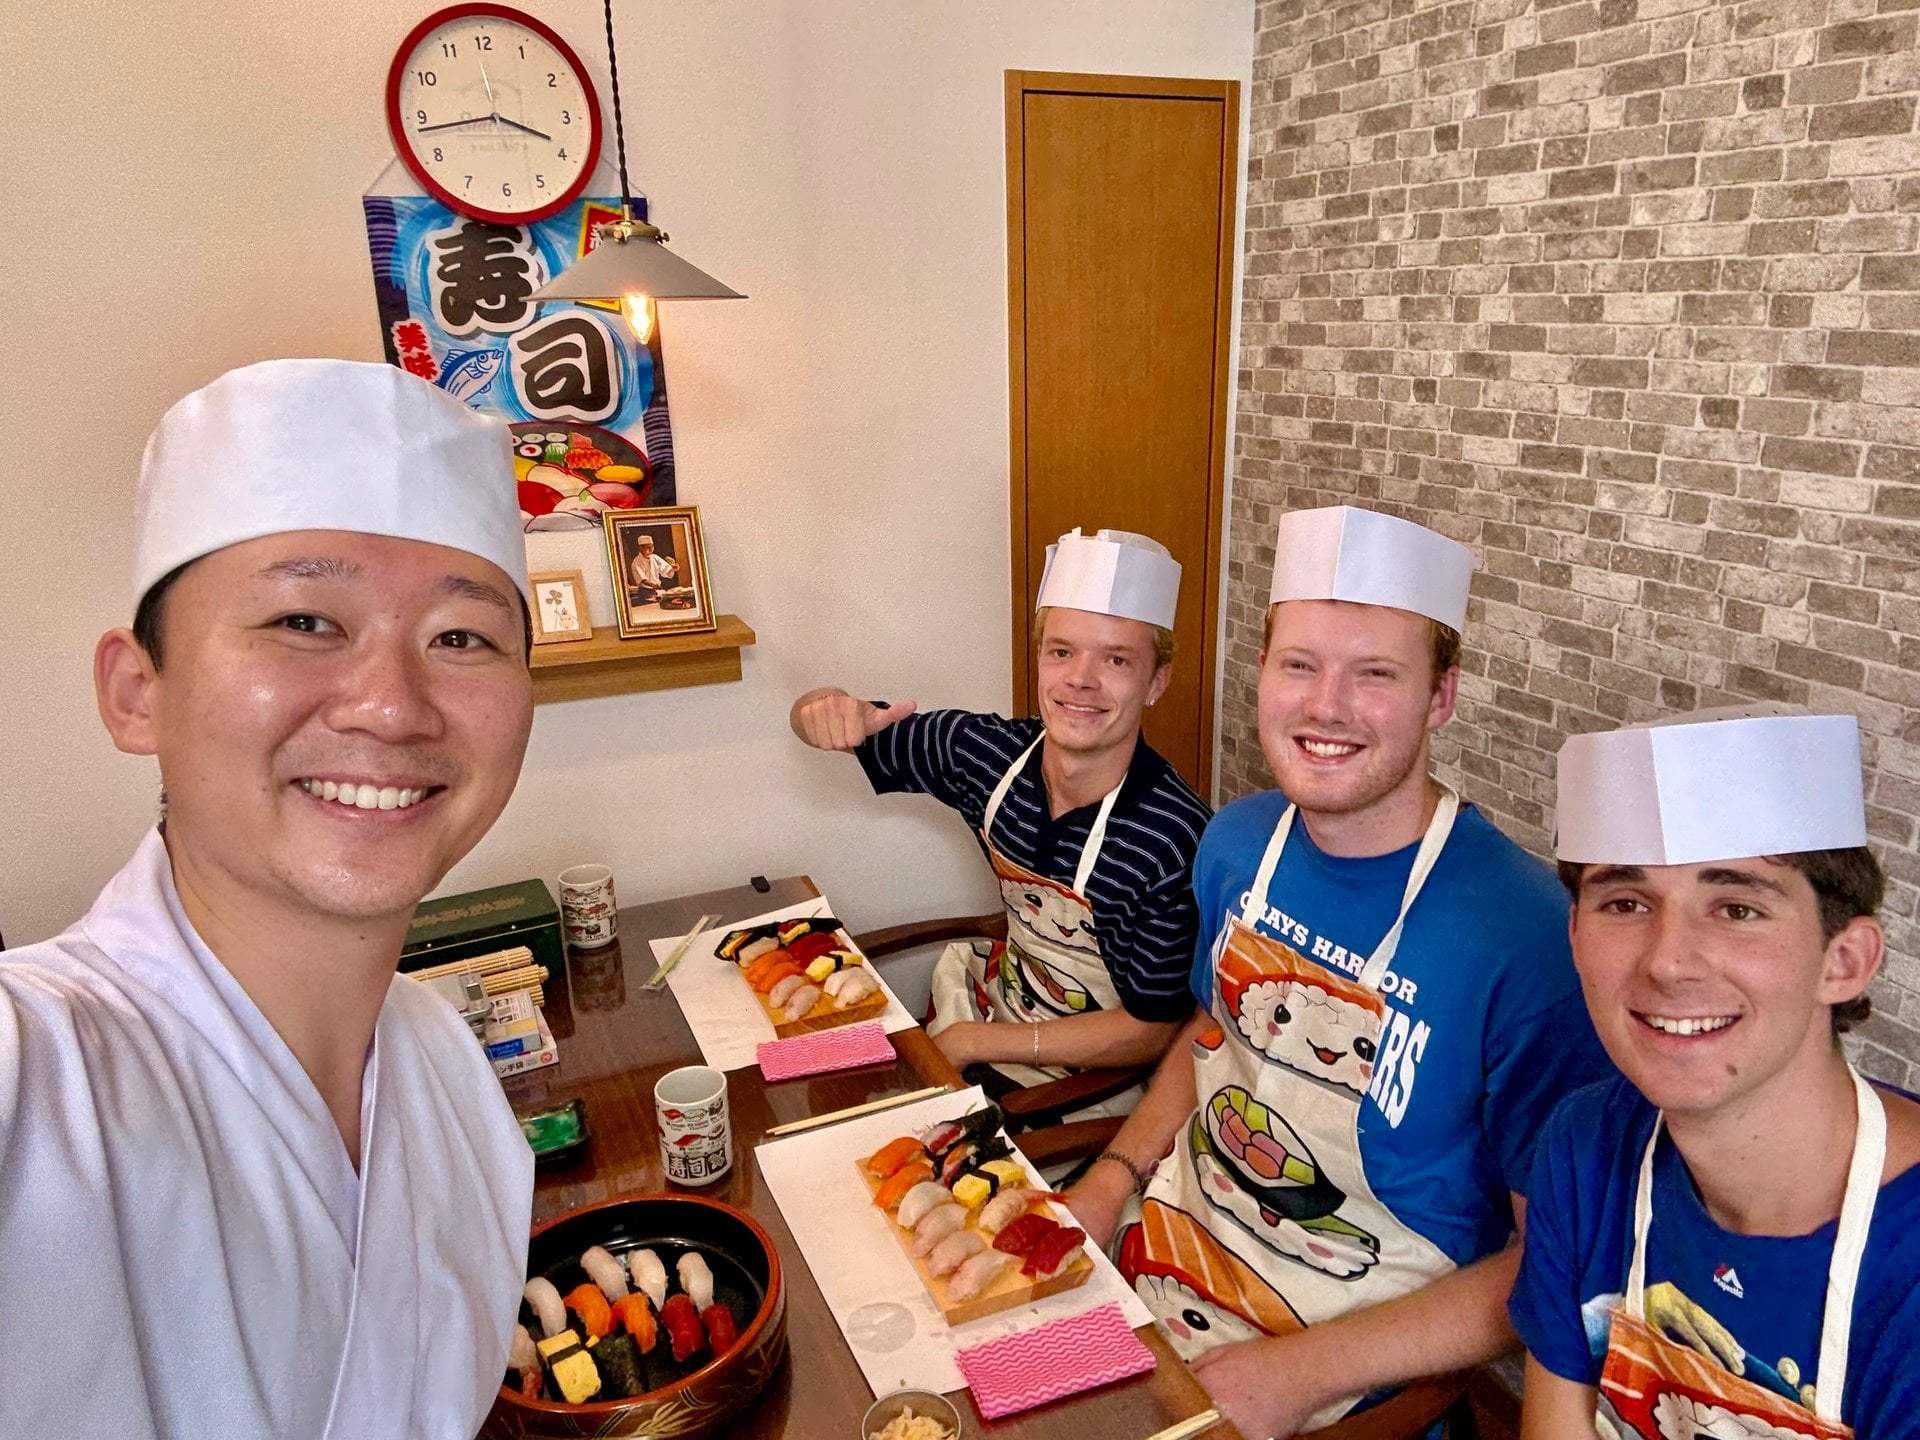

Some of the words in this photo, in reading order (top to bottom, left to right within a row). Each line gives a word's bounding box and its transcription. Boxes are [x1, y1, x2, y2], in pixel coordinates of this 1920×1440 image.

[442, 43, 457, 58] 11
[475, 36, 492, 51] 12
[518, 46, 526, 60] 1
[418, 71, 437, 86] 10
[547, 73, 557, 88] 2
[417, 110, 427, 124] 9
[562, 110, 571, 125] 3
[434, 148, 444, 162] 8
[557, 147, 567, 161] 4
[464, 175, 473, 189] 7
[536, 175, 545, 188] 5
[502, 183, 512, 197] 6
[434, 219, 611, 413] 寿司
[395, 322, 439, 381] 美味
[1311, 935, 1418, 1006] HAROR
[1713, 1275, 1744, 1299] Majestic
